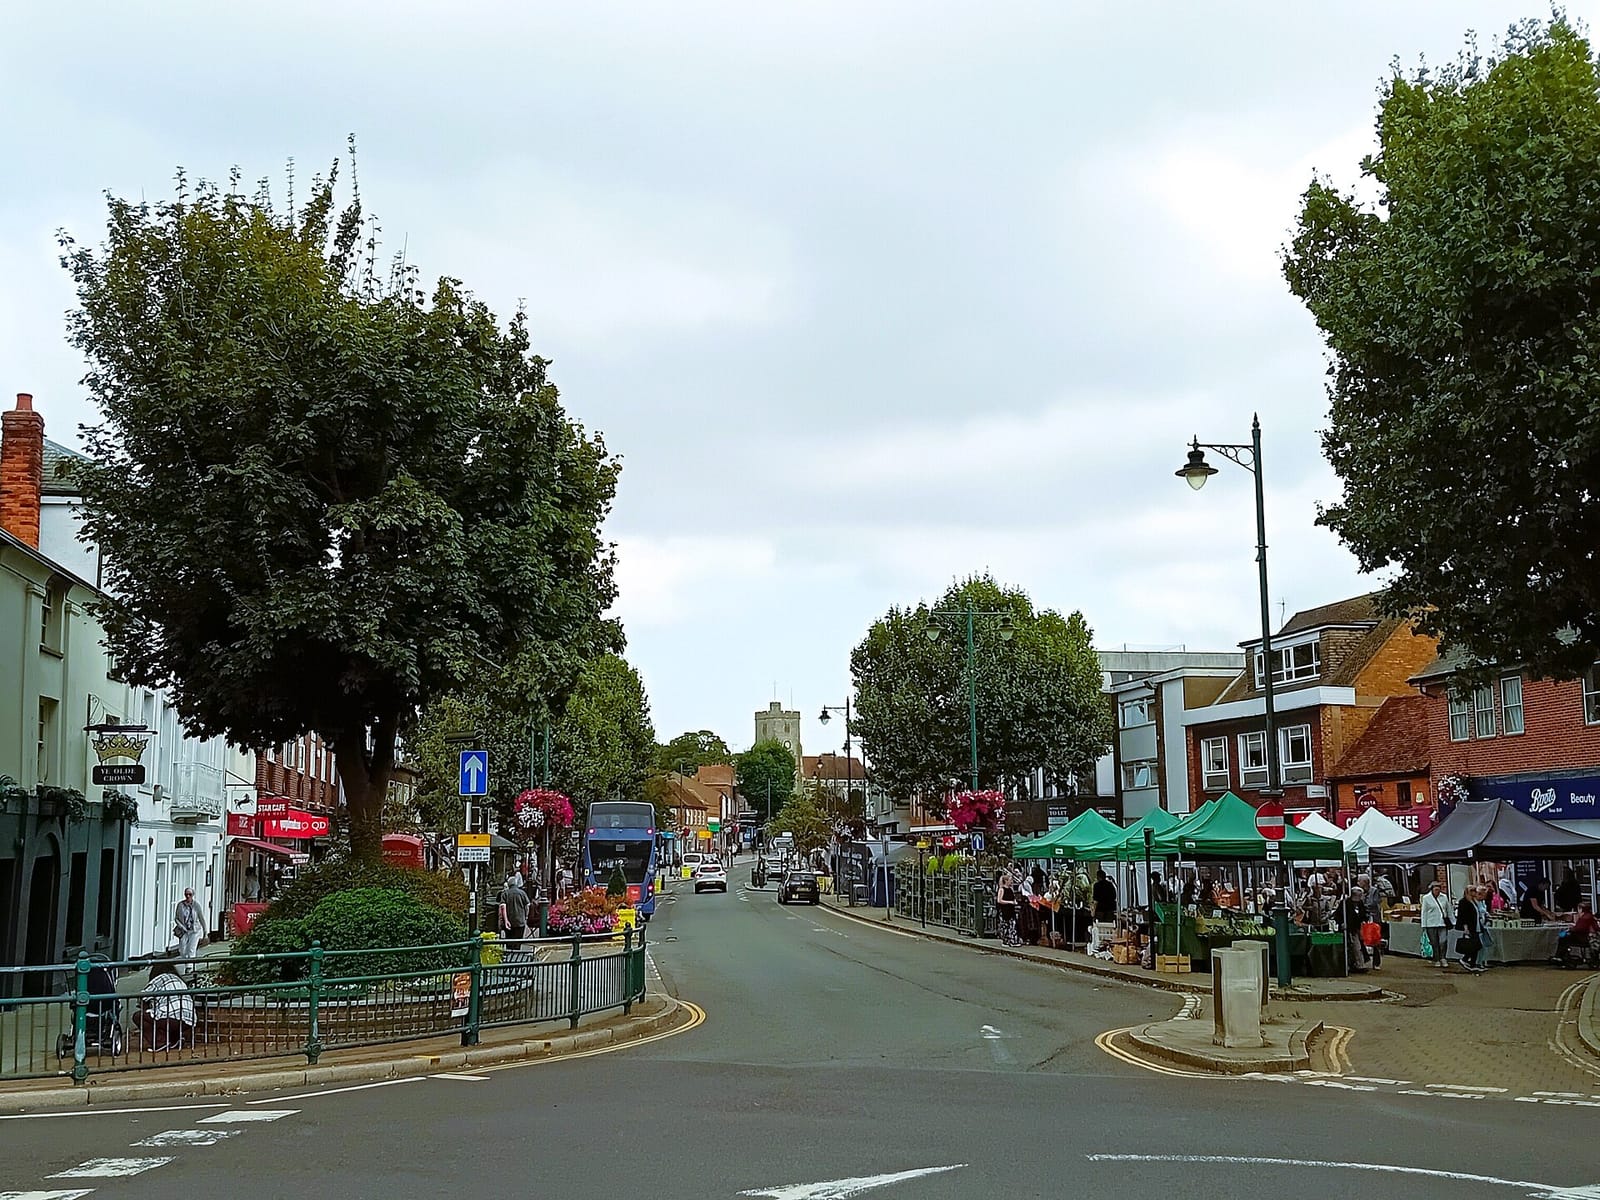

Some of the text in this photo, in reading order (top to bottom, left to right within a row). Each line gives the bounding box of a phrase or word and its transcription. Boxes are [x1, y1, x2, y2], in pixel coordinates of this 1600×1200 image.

[1529, 787, 1556, 812] Boots
[1570, 793, 1595, 806] Beauty
[258, 803, 286, 812] STAR CAFE
[1387, 815, 1419, 829] FFEE
